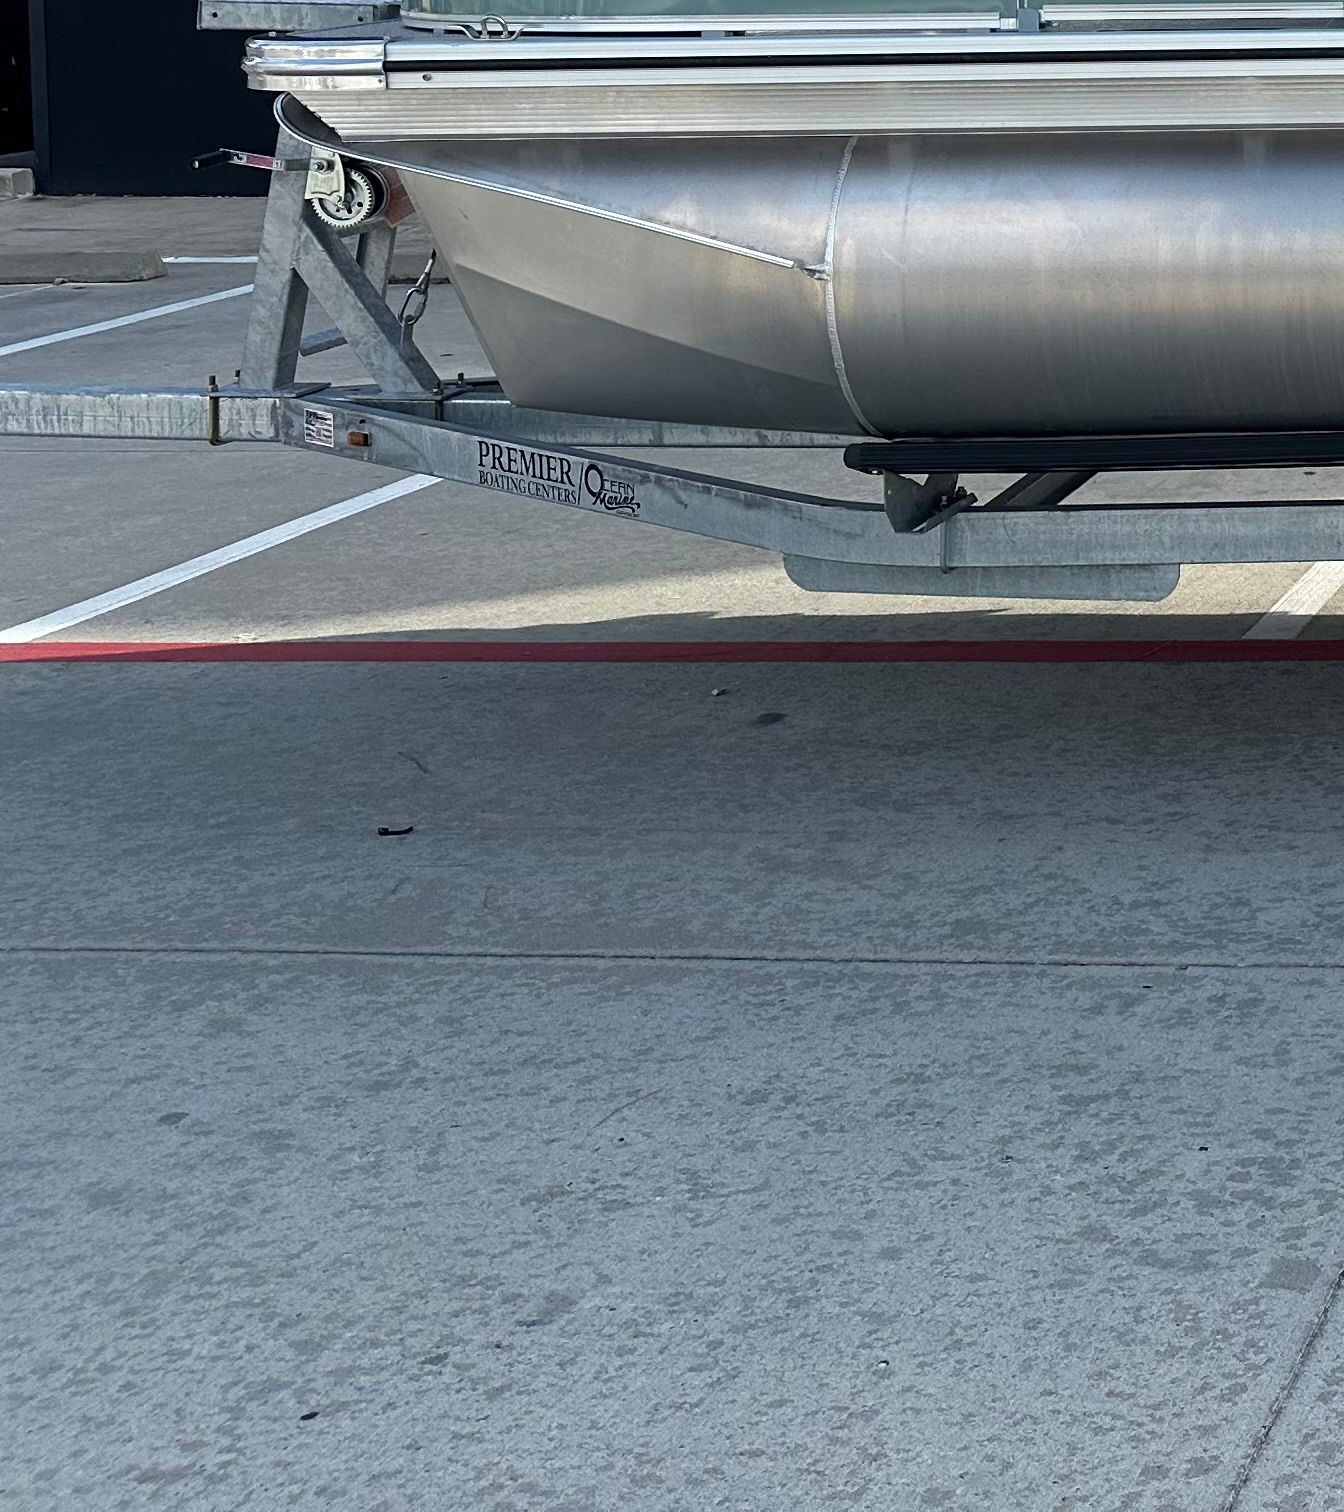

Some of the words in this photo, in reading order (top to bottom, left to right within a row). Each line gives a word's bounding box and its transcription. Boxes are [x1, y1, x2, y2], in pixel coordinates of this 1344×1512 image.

[477, 440, 576, 487] PREMIER
[478, 469, 527, 494] BOATING
[527, 479, 577, 505] CENTERS
